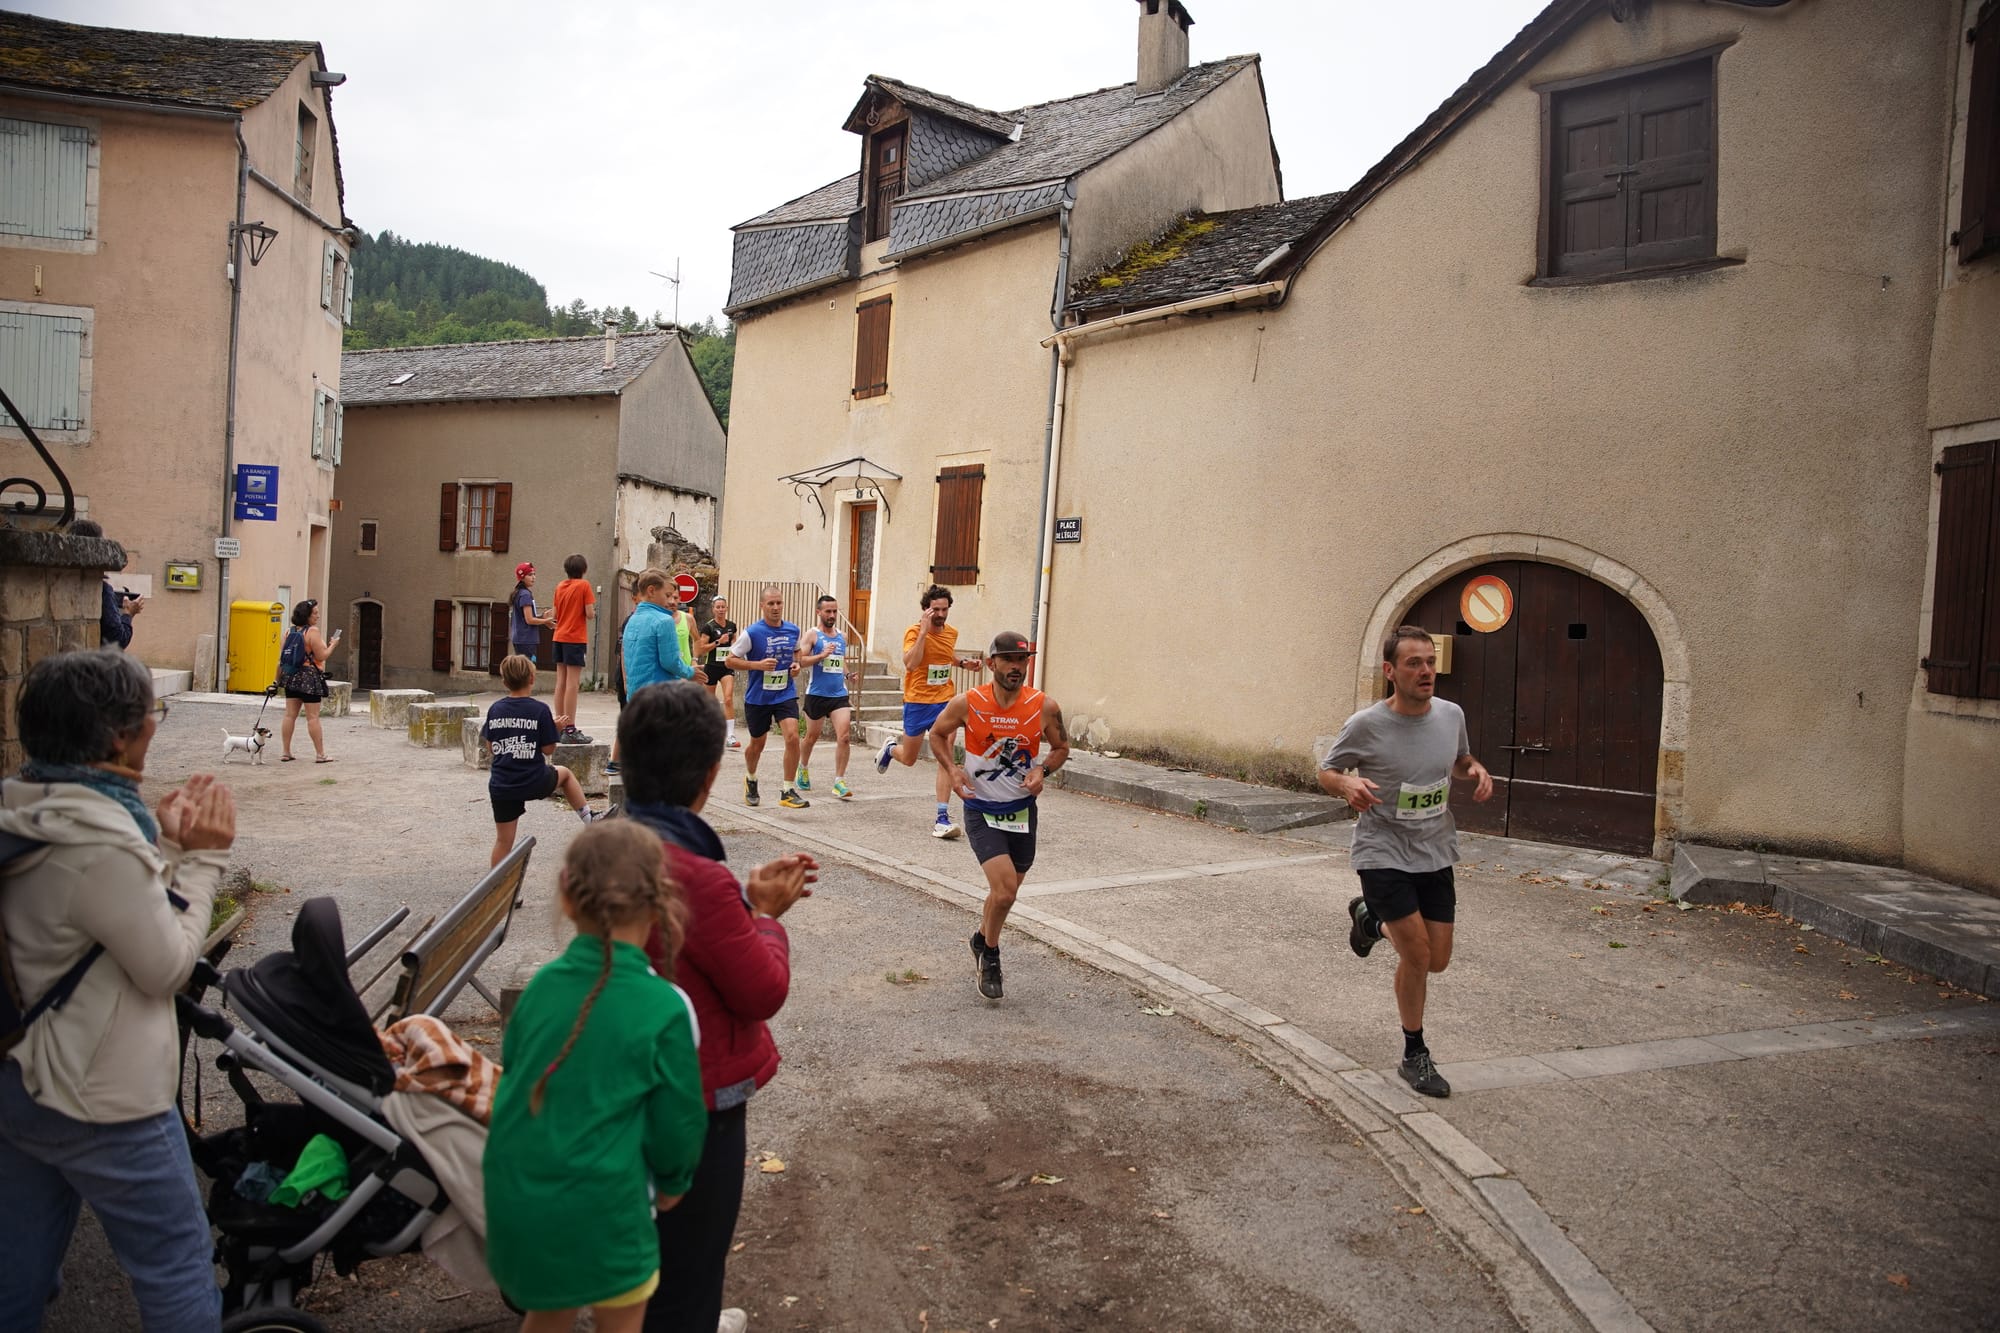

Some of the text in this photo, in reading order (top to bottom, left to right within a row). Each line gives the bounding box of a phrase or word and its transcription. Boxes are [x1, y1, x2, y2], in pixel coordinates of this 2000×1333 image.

[1060, 521, 1076, 529] PLACE
[830, 659, 840, 667] 70
[771, 675, 783, 684] 77
[489, 717, 538, 730] ORGANISATION
[990, 716, 1019, 724] STRAVA
[1407, 789, 1443, 809] 136
